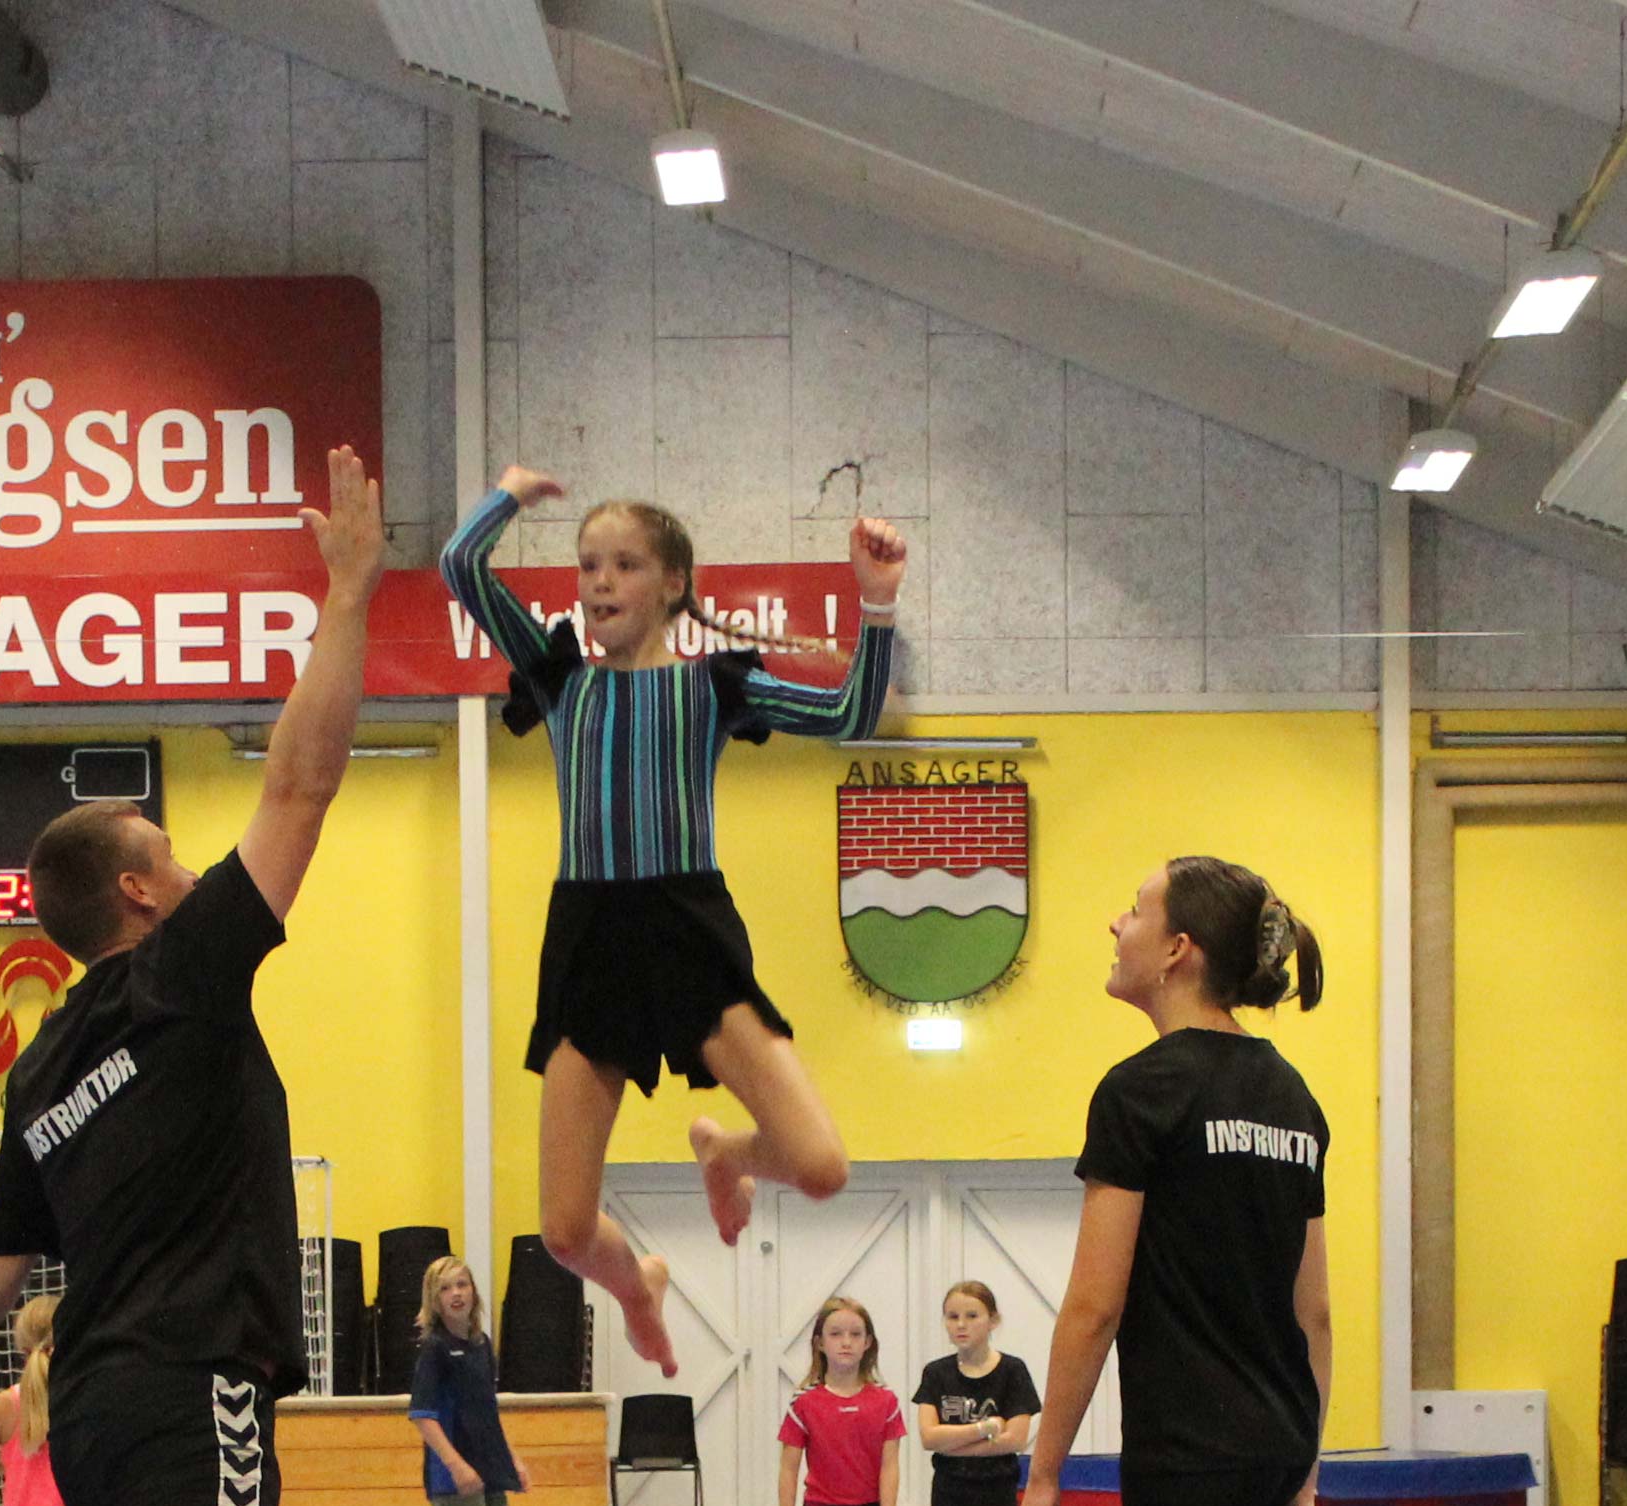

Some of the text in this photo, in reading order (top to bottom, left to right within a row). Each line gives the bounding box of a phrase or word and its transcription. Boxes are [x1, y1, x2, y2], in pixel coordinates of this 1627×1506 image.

[61, 766, 77, 784] G
[845, 760, 1022, 785] ANSAGER
[940, 1394, 999, 1423] FILA
